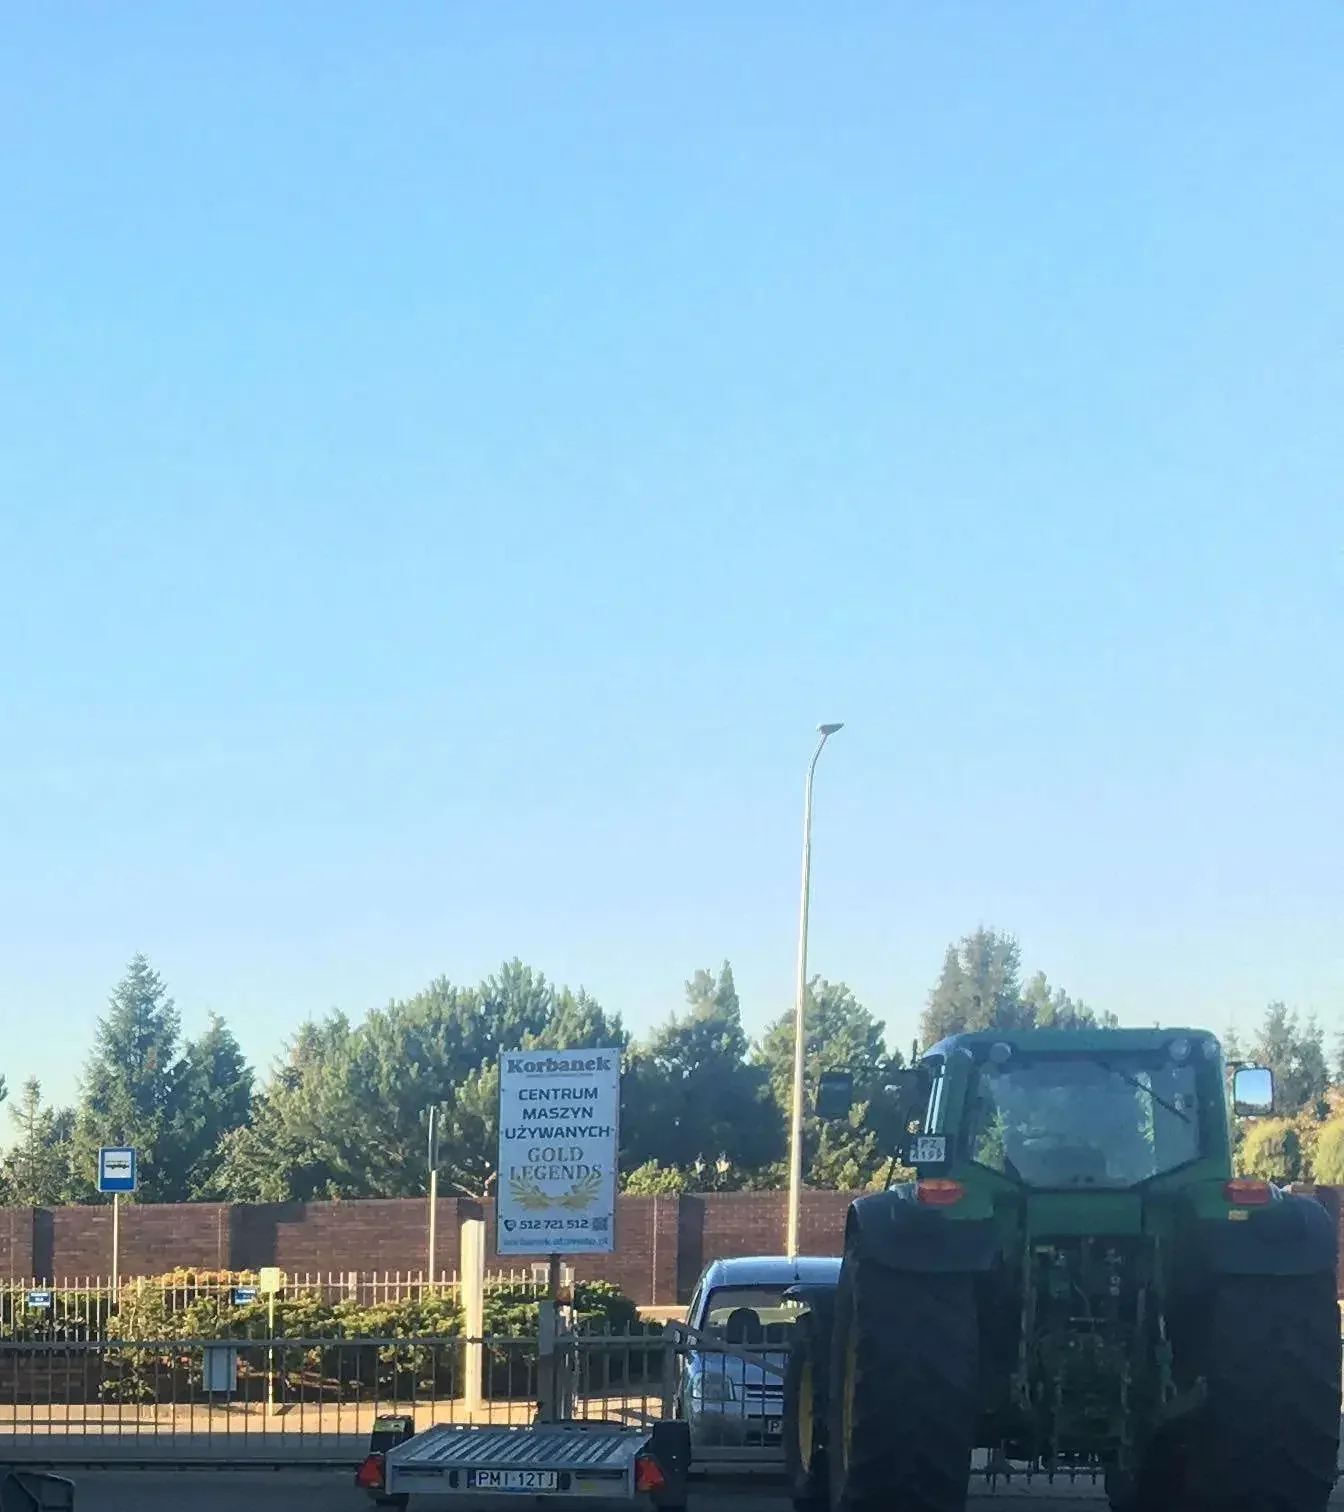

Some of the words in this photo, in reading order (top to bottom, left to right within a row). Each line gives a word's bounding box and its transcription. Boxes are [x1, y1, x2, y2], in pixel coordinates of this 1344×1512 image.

[507, 1056, 612, 1074] Korbanek
[518, 1087, 599, 1101] CENTRUM
[522, 1106, 594, 1120] MASZYN
[505, 1124, 611, 1140] UŻYWANYCH
[527, 1146, 584, 1162] GOLD
[510, 1164, 602, 1181] LEGENDS
[519, 1220, 541, 1230] 512
[544, 1220, 564, 1230] 721
[567, 1219, 589, 1229] 512
[478, 1472, 509, 1486] PMI
